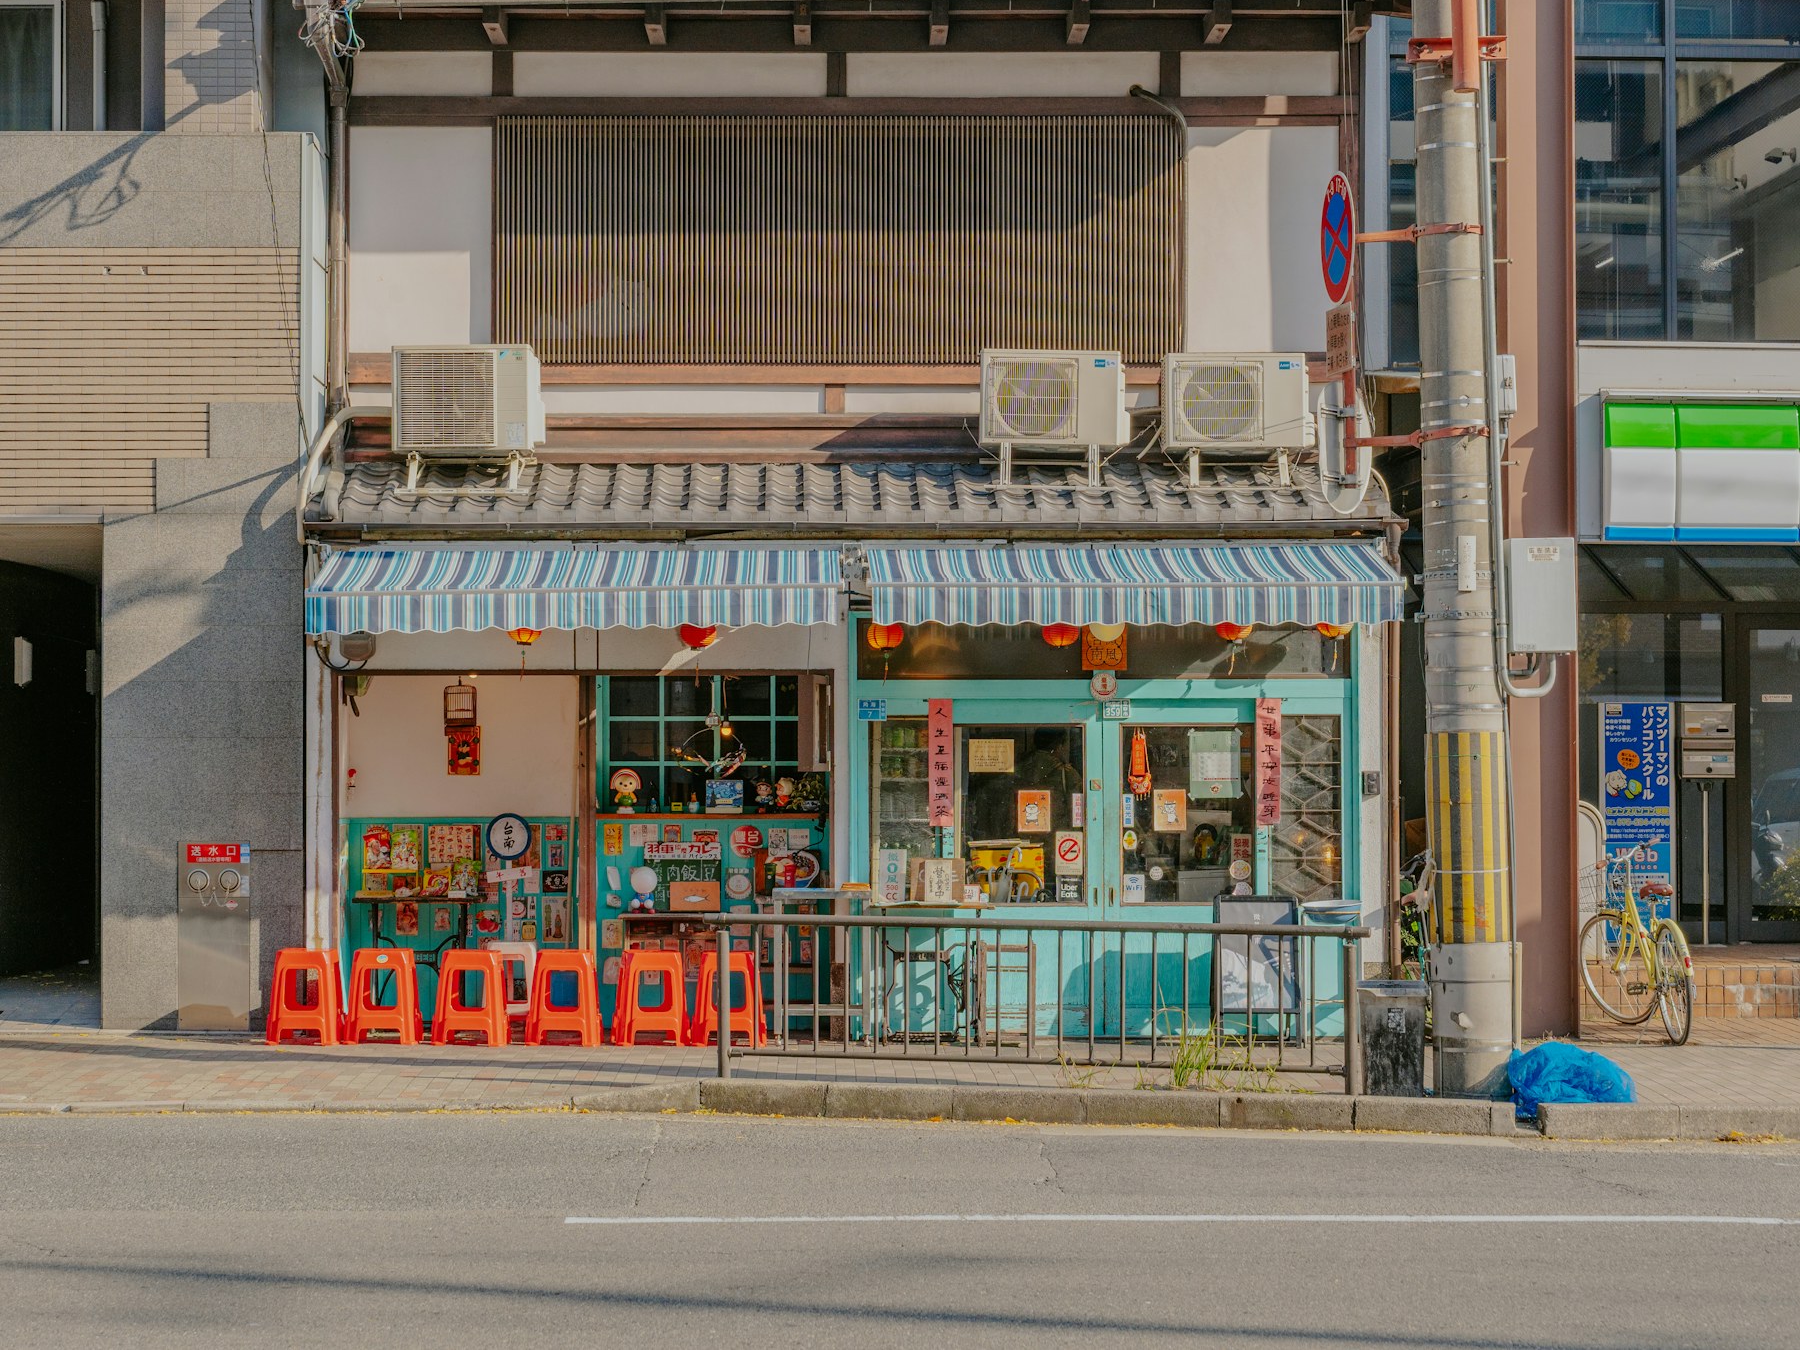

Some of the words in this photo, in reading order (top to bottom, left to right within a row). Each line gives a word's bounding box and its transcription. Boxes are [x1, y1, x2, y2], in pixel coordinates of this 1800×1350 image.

[1642, 705, 1655, 800] パソコンスクール
[1656, 706, 1669, 786] マンツーマンの
[503, 821, 515, 852] 台南
[191, 845, 237, 857] 送水口
[885, 892, 898, 901] CC
[1060, 883, 1078, 891] Uber
